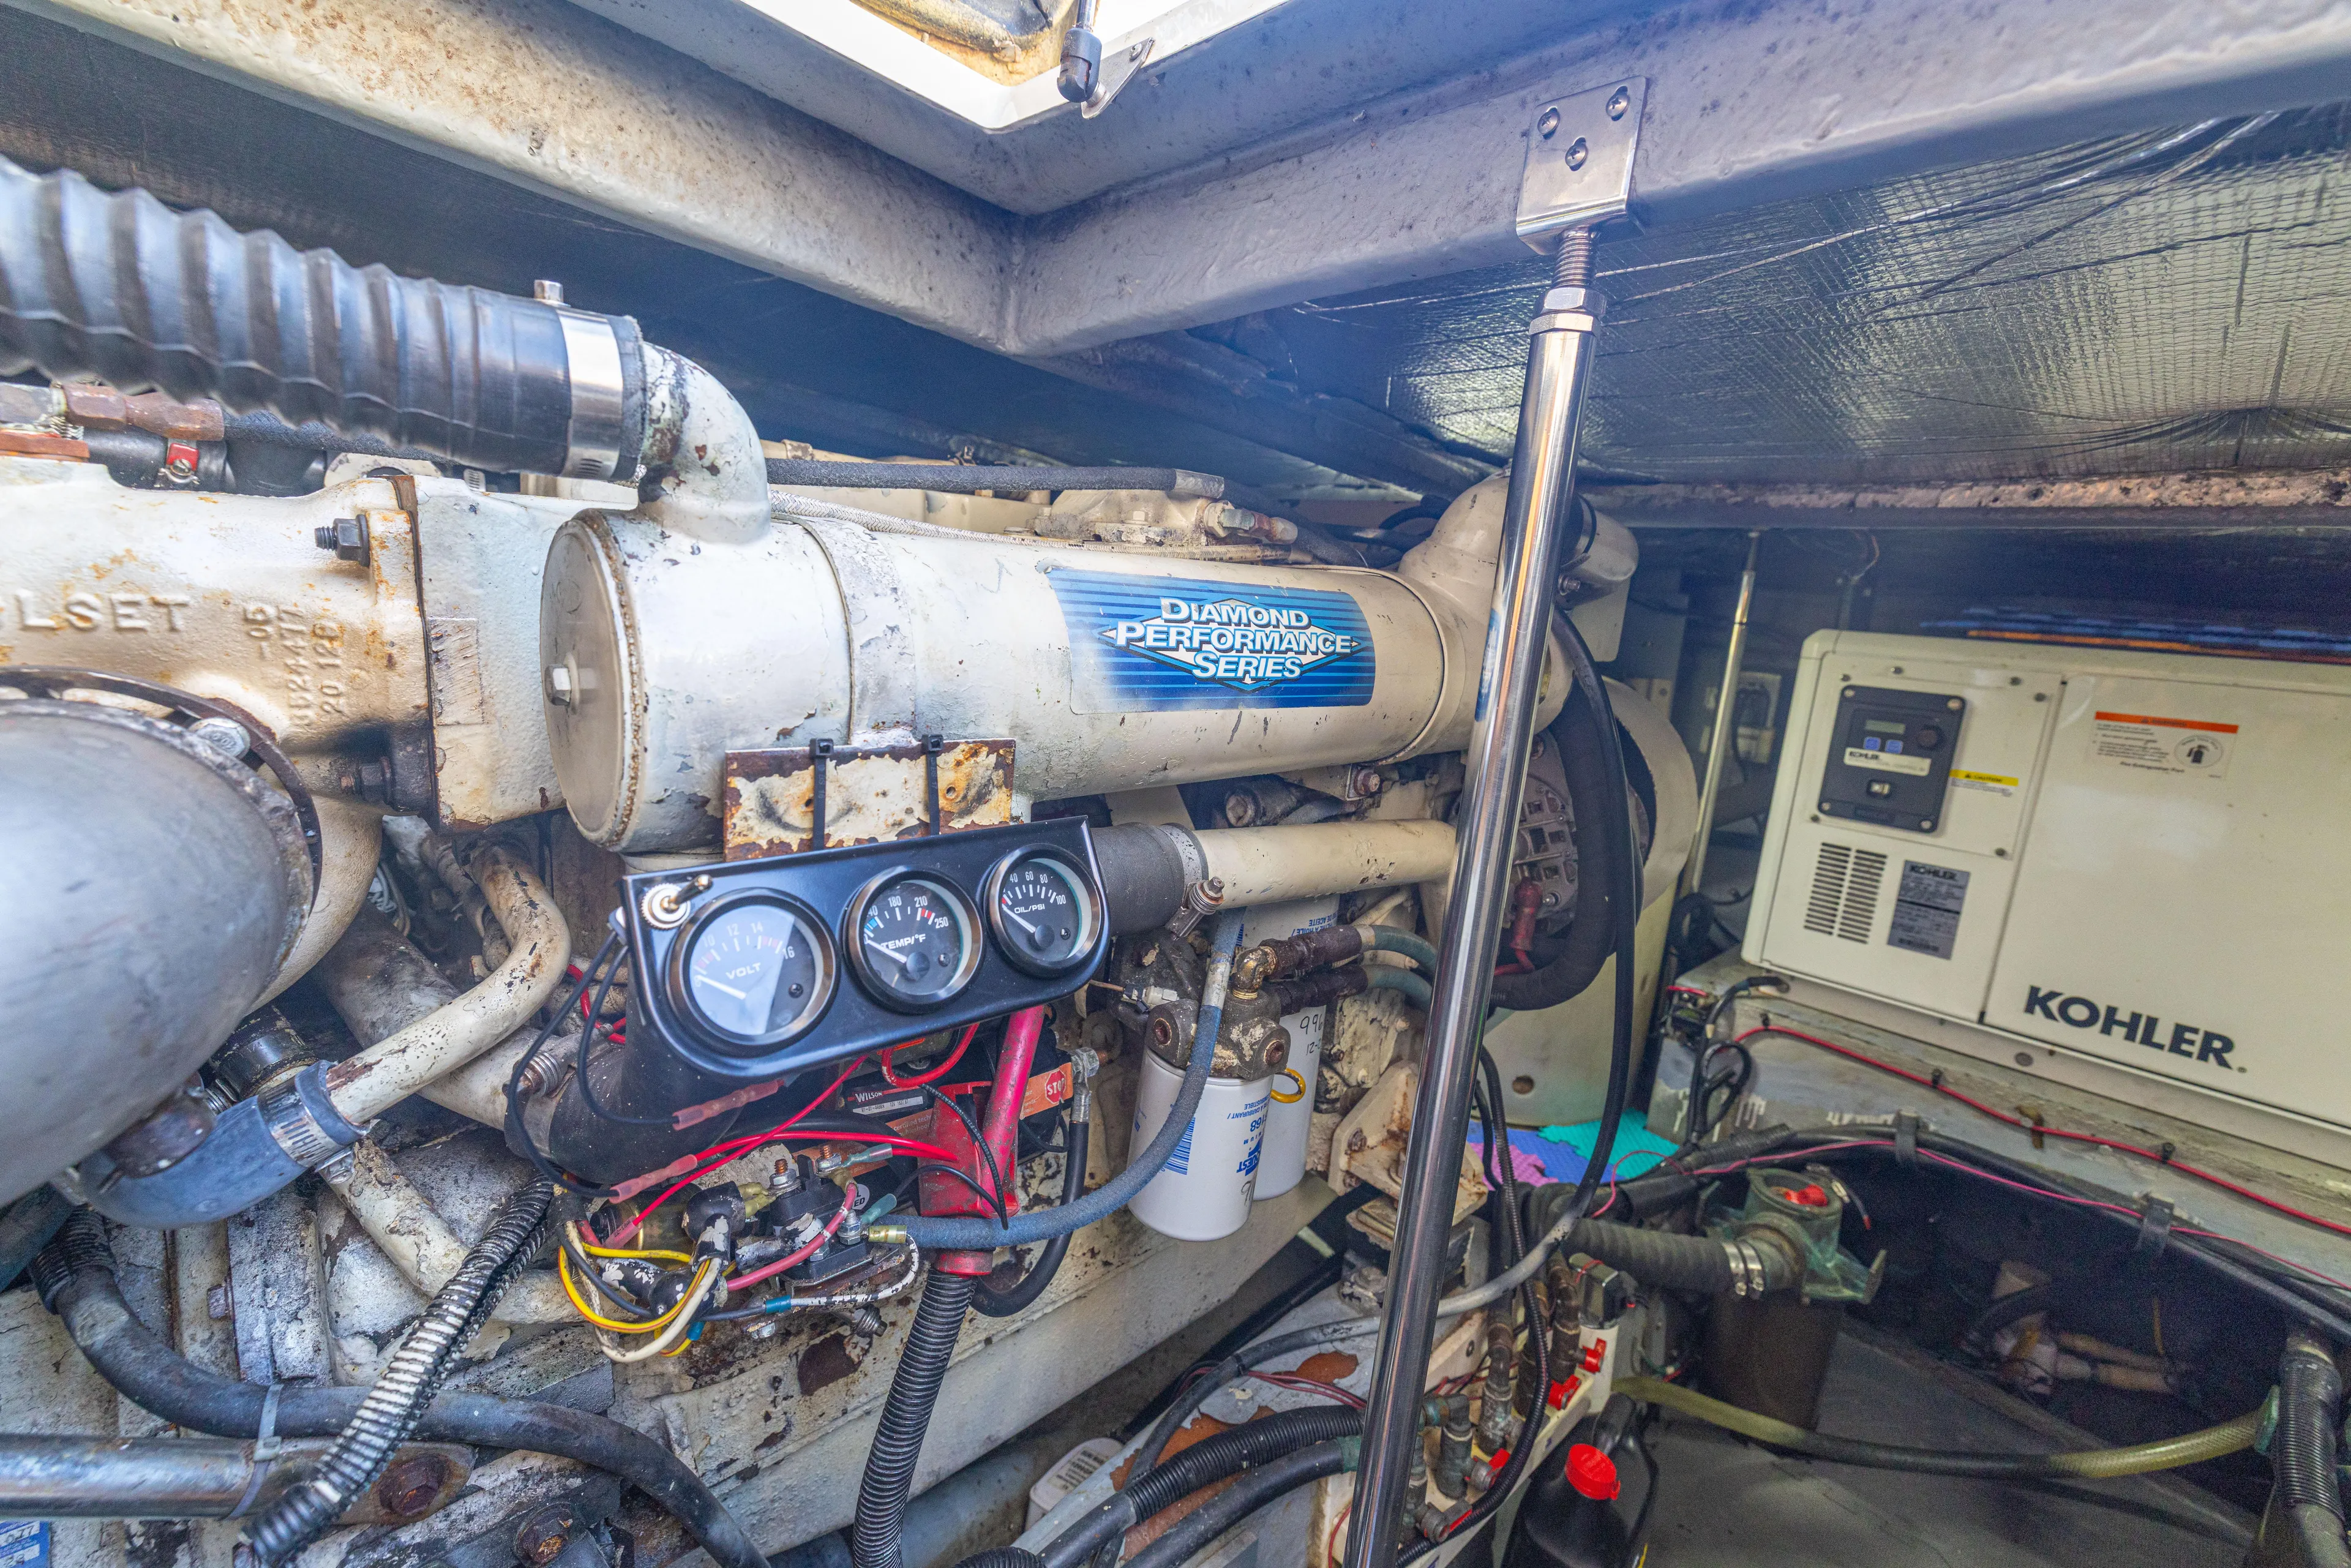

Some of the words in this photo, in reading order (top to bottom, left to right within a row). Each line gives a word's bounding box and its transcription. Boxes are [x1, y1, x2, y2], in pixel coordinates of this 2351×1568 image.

[0, 589, 189, 634] LSET
[1161, 597, 1310, 626] DIAMOND
[1116, 621, 1352, 653] PERFORMANCE
[1193, 651, 1302, 678] SERIES
[1010, 873, 1018, 883] 40
[1025, 871, 1034, 881] 60
[1040, 874, 1048, 883] 80
[888, 895, 902, 907] 180
[914, 895, 928, 907] 210
[1056, 895, 1067, 905] 100
[867, 905, 879, 917] 40
[1014, 903, 1046, 914] OIL/PSI
[750, 921, 763, 934] 14
[934, 916, 949, 929] 250
[1308, 916, 1327, 926] ACEITE
[726, 923, 740, 937] 12
[703, 934, 716, 948] 10
[782, 946, 795, 959] 16
[726, 962, 761, 980] VOLT
[2024, 985, 2233, 1070] KOHLER
[1047, 1078, 1065, 1095] STOP
[855, 1091, 882, 1103] WILSON
[1231, 1106, 1261, 1119] CARBURANT
